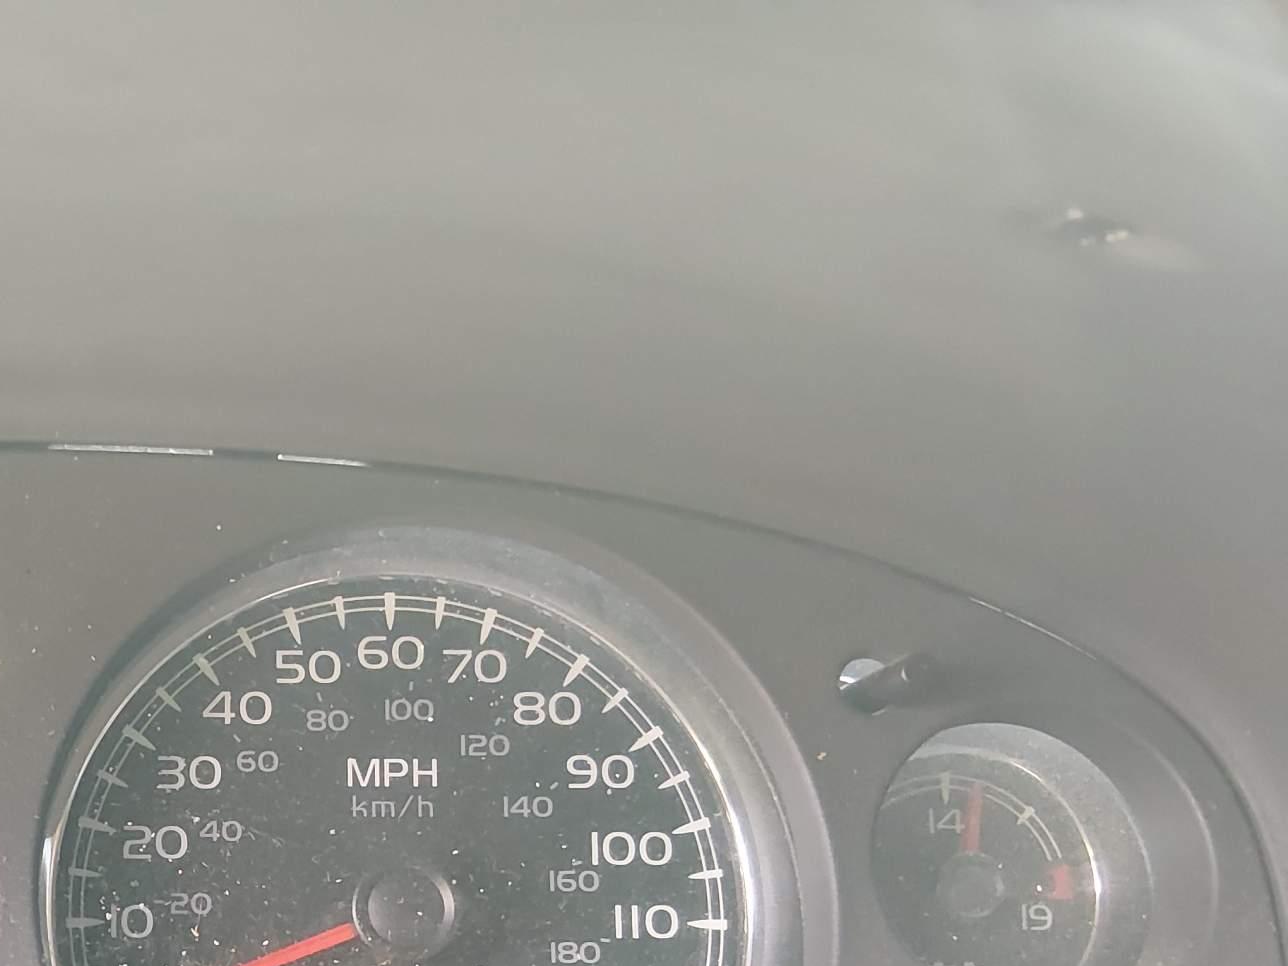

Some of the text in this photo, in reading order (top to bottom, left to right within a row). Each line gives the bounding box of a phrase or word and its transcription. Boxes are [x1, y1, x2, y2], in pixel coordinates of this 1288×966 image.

[275, 651, 341, 683] 50
[357, 637, 424, 669] 60
[443, 650, 507, 684] 70
[202, 691, 272, 725] 40
[306, 710, 349, 732] 80
[384, 698, 434, 721] 100
[513, 692, 582, 725] 80
[460, 735, 510, 757] 120
[156, 756, 222, 789] 30
[236, 750, 279, 773] 60
[347, 758, 439, 787] MPH
[566, 756, 635, 789] 90
[351, 795, 435, 820] km/h
[502, 795, 553, 818] 140
[199, 820, 242, 842] 40
[928, 808, 965, 834] 14
[122, 826, 188, 860] 20
[591, 832, 672, 865] 100
[549, 870, 600, 892] 160
[171, 893, 212, 914] 20
[1021, 903, 1052, 931] 19
[111, 904, 153, 938] 10
[614, 905, 679, 939] 110
[550, 941, 601, 964] 180
